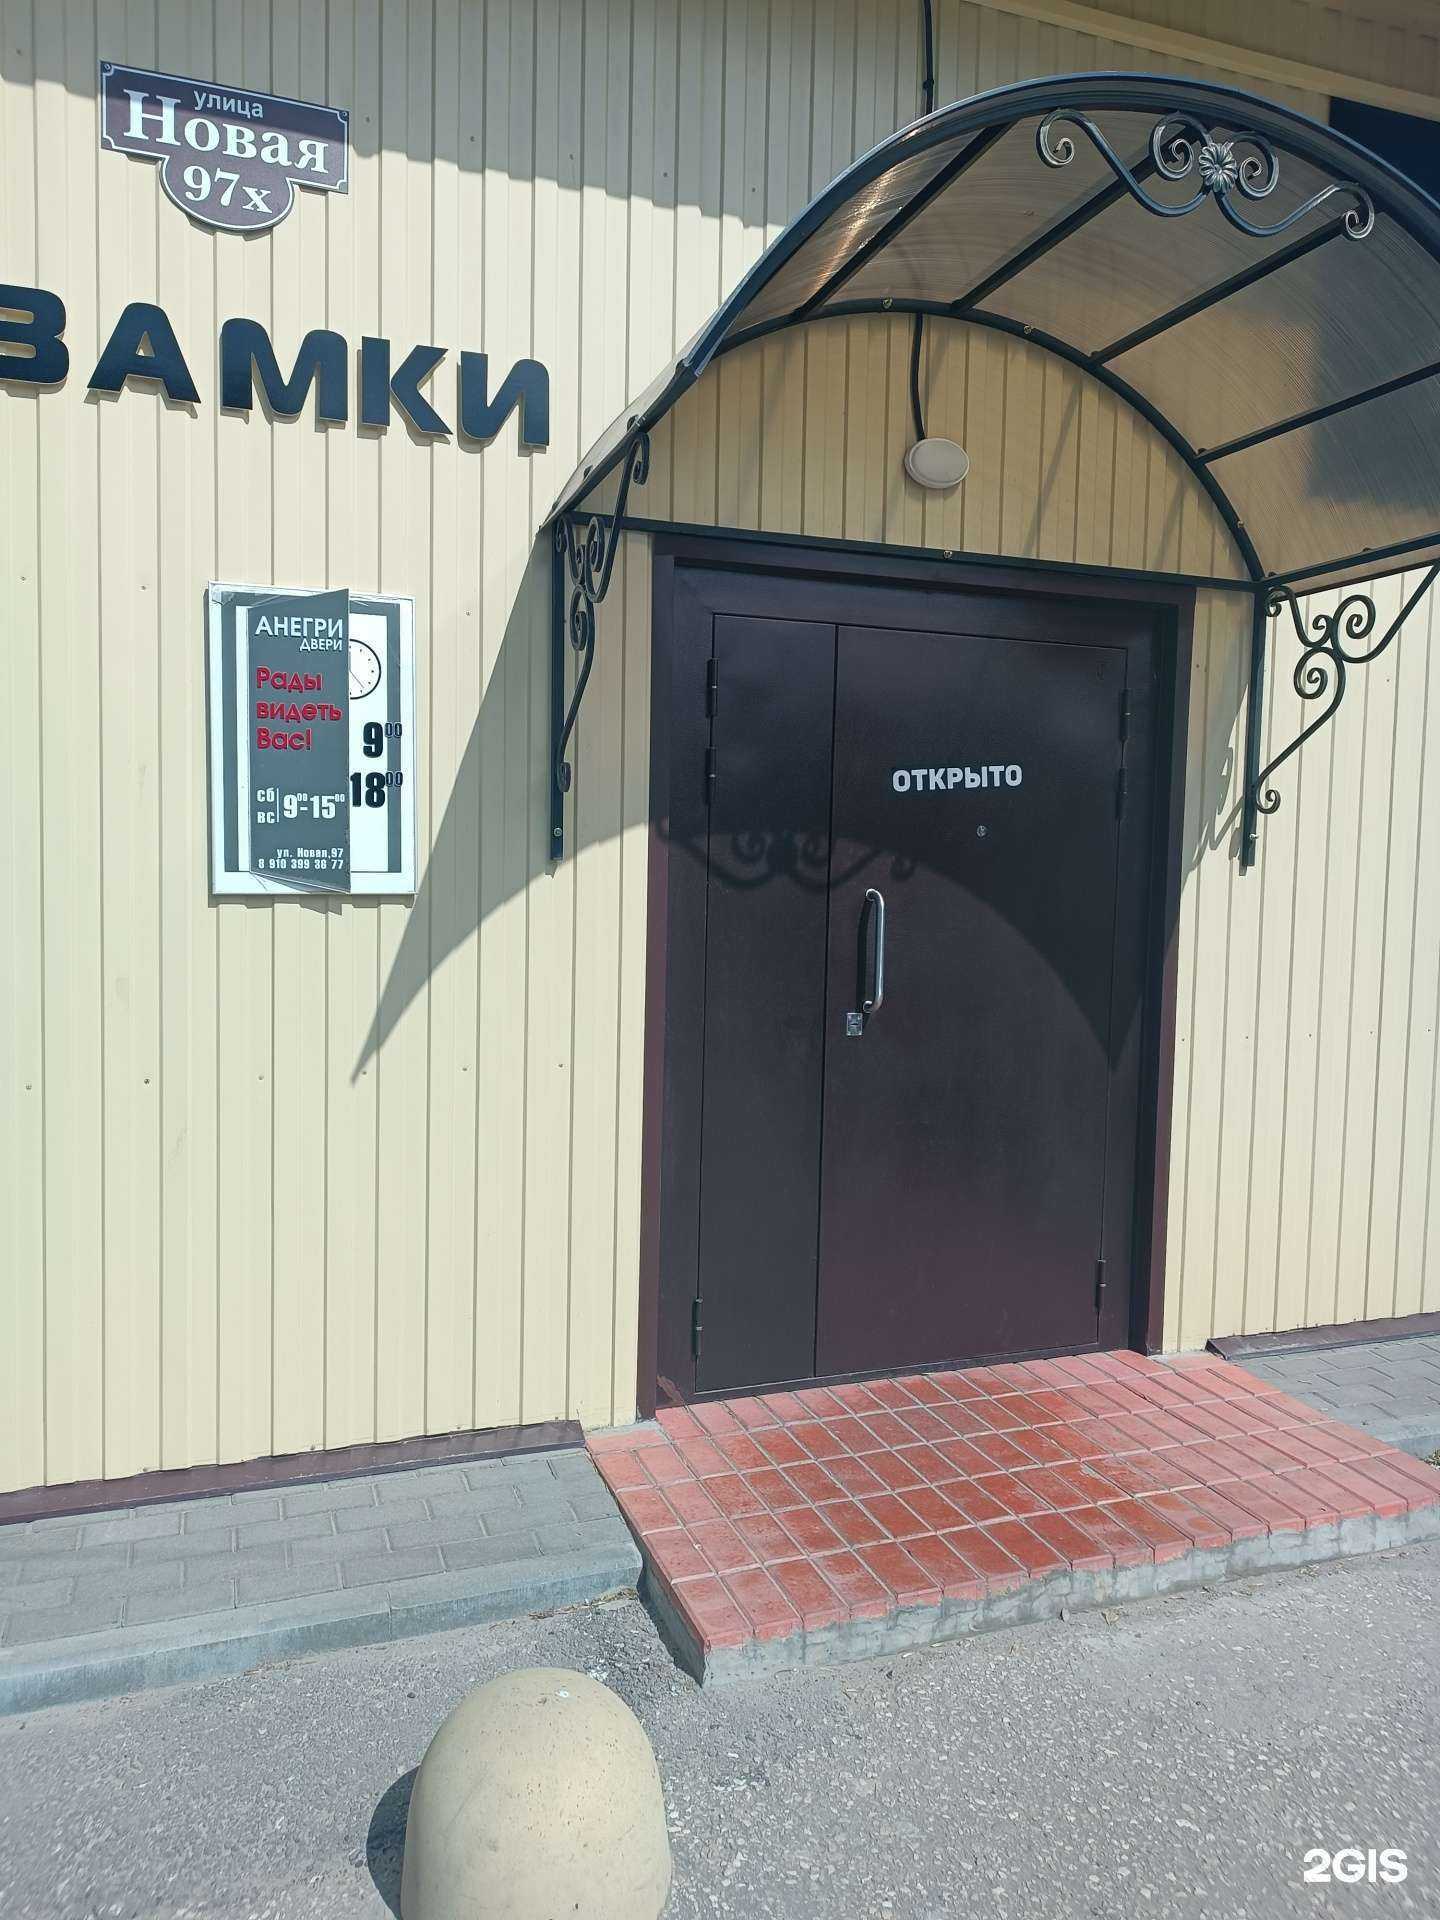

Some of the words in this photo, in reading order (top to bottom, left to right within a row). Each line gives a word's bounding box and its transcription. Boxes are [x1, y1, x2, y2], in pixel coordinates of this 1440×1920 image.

[193, 90, 264, 119] улица
[123, 89, 329, 174] Новая
[183, 165, 273, 214] 97х
[254, 615, 343, 638] АНЕГРИ
[299, 638, 343, 651] ДВЕРИ
[256, 666, 323, 693] Рады
[256, 700, 342, 723] видеть
[256, 727, 312, 750] Вас!
[892, 764, 1023, 792] ОТКРЫТО
[258, 858, 265, 869] 8
[290, 858, 310, 869] 399
[331, 859, 344, 870] 77
[276, 848, 293, 859] ул.
